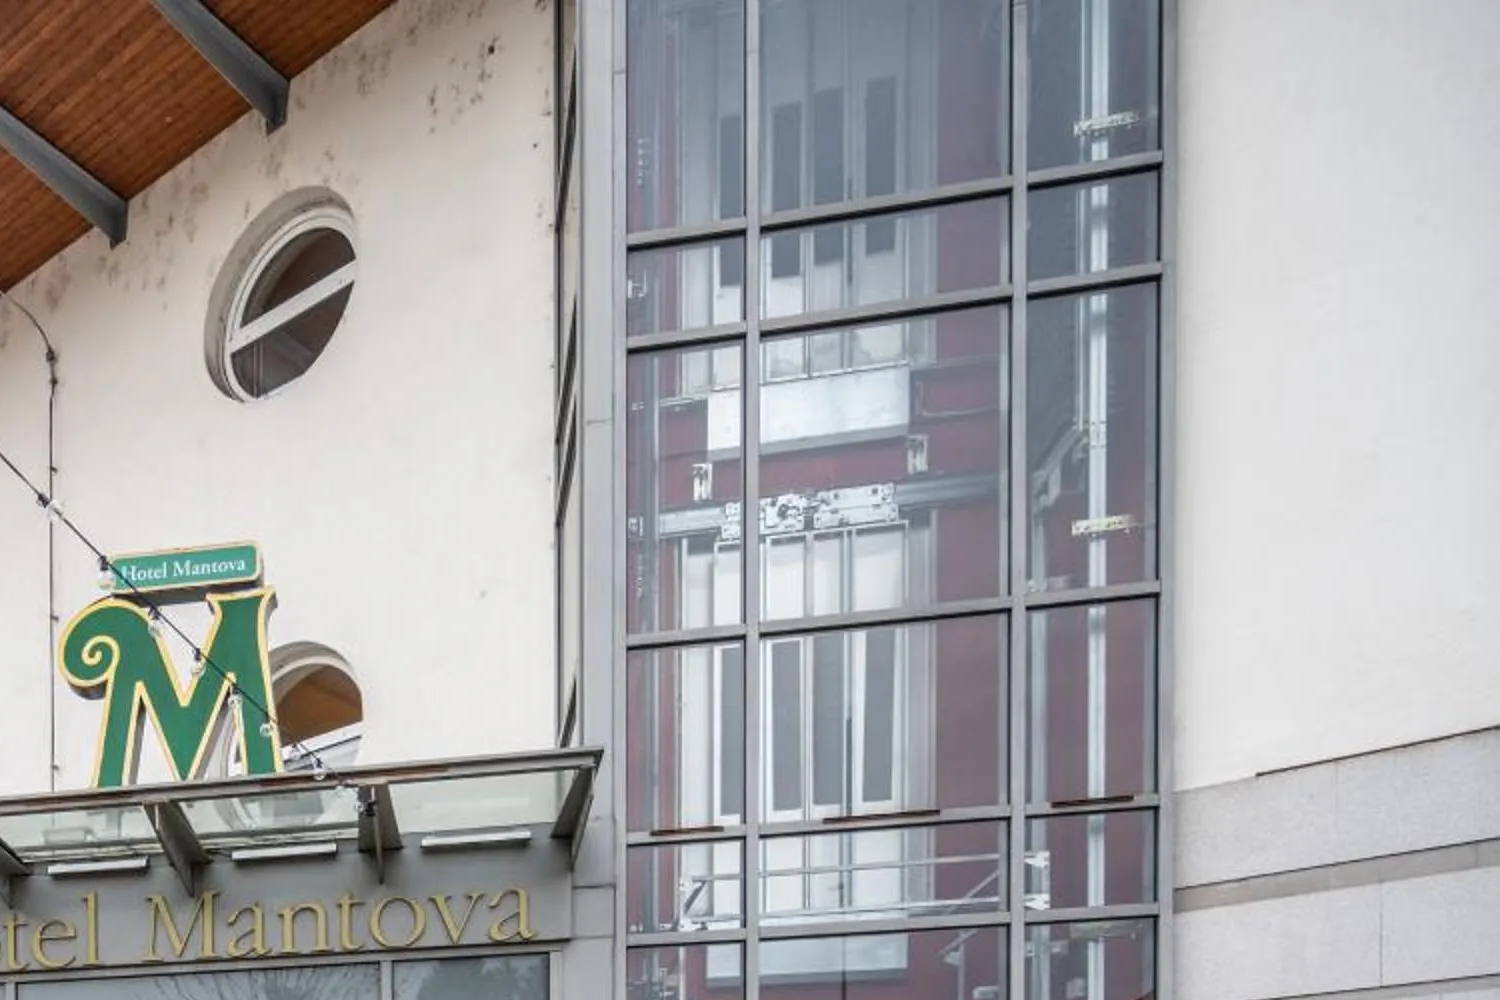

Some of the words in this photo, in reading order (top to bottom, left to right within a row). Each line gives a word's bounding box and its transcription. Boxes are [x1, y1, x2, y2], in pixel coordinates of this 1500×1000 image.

[120, 561, 168, 583] Hotel
[172, 559, 246, 577] Mantova
[143, 884, 538, 968] Mantova
